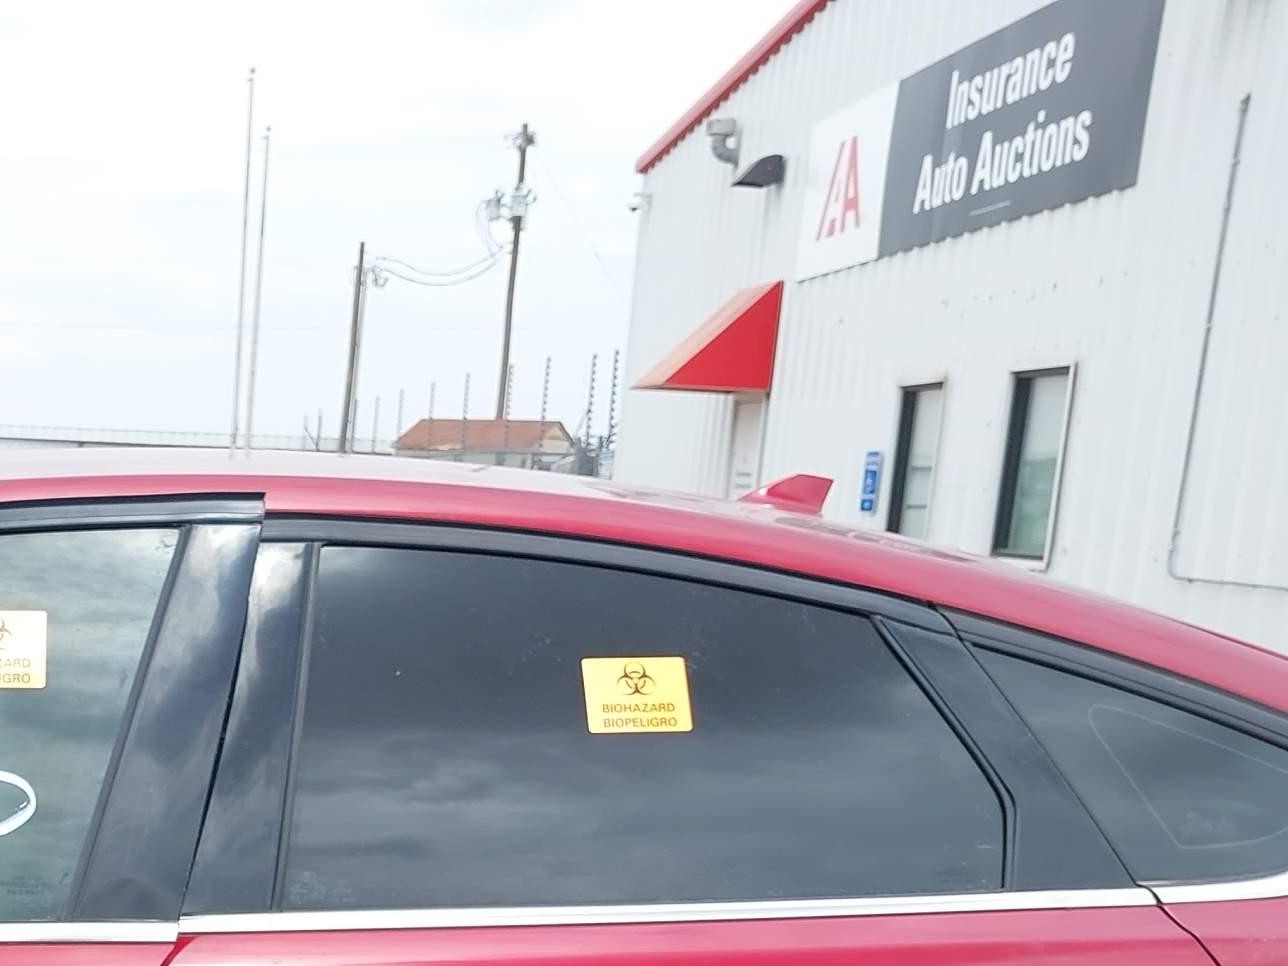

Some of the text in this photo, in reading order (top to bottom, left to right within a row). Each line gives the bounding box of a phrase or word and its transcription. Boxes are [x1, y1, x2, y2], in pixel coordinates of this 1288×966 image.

[945, 31, 1076, 130] Insurance
[912, 107, 1093, 214] Auto Auctions
[602, 703, 676, 713] BIOHAZARD
[603, 716, 677, 728] BIOPELIGRO
